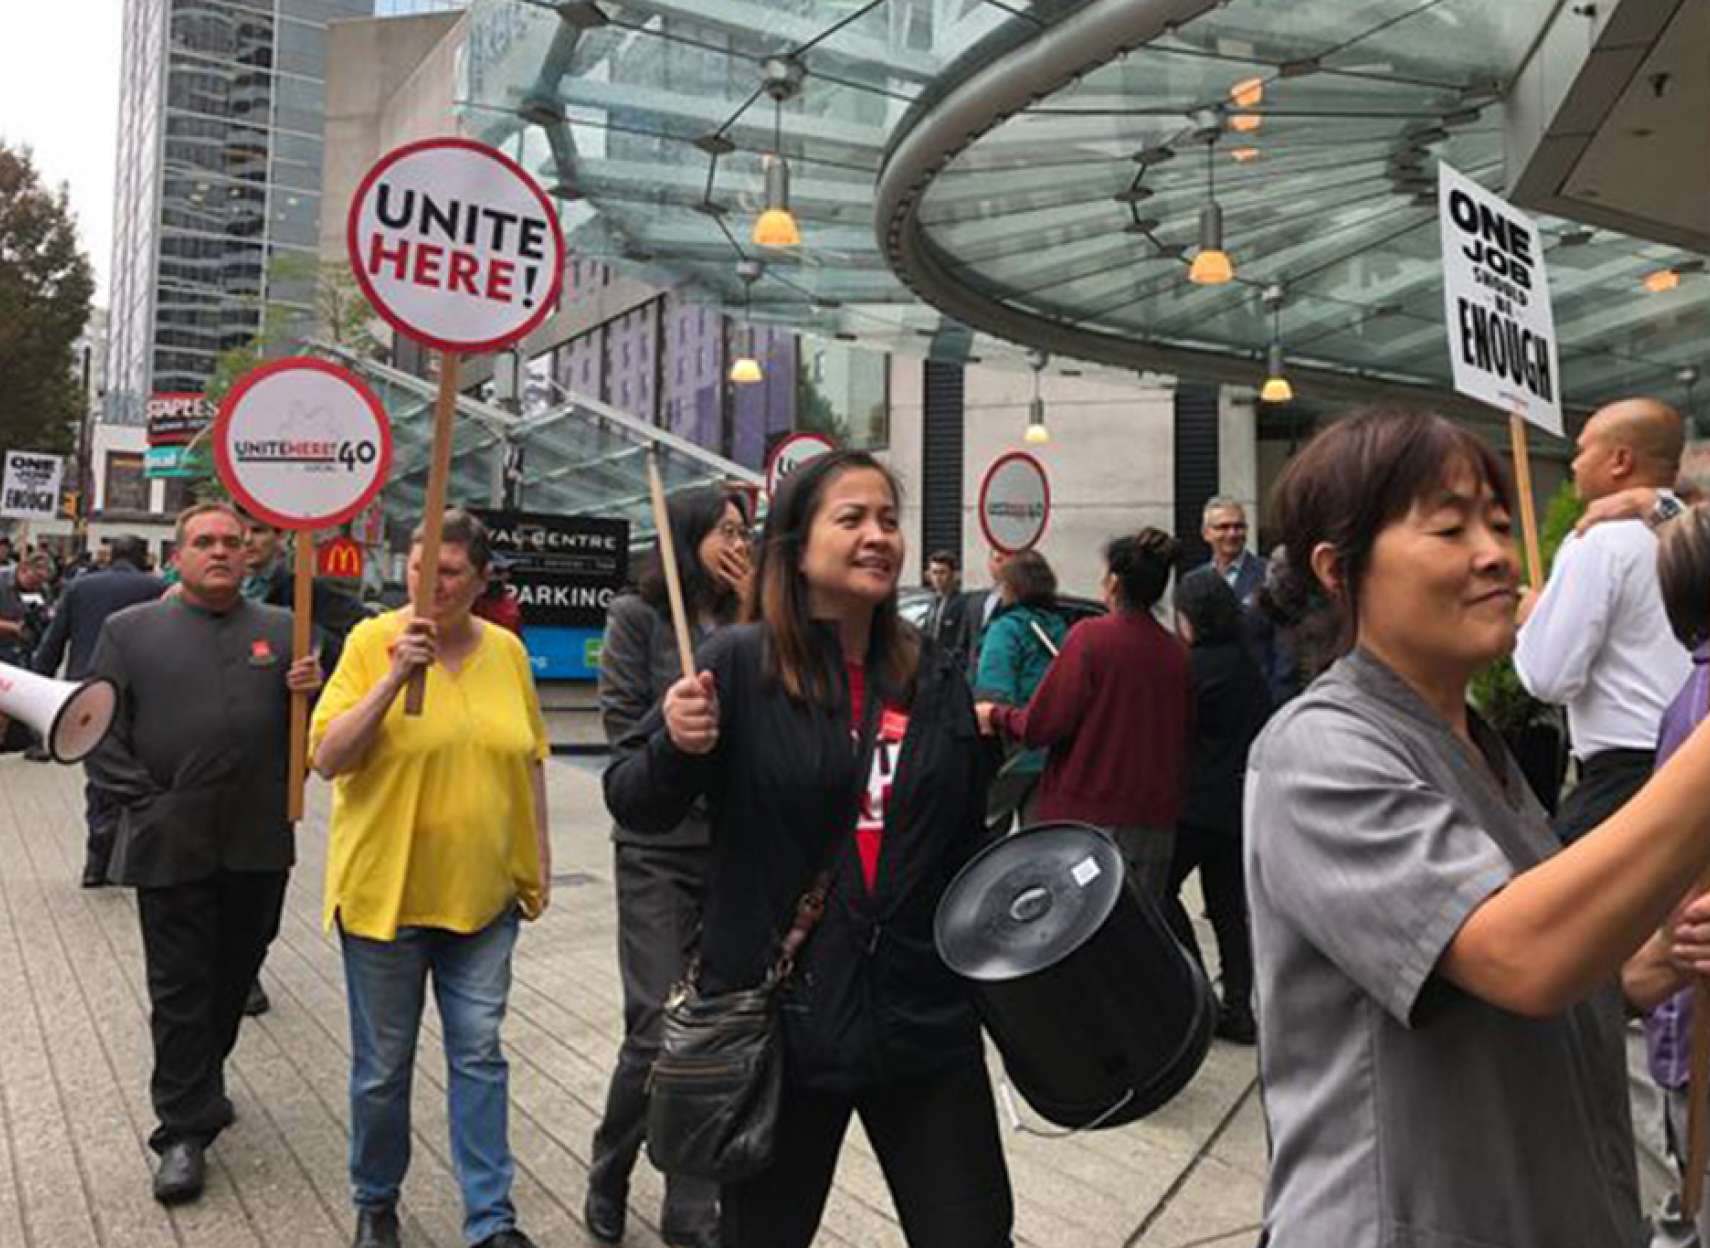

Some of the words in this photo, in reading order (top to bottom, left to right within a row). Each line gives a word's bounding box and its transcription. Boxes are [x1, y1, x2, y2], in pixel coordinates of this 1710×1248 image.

[376, 183, 547, 260] UNITE
[1450, 189, 1535, 268] ONE
[369, 232, 538, 309] HERE!
[1462, 239, 1531, 290] JOB
[1457, 297, 1553, 404] ENOUGH
[11, 456, 55, 474] ONE
[338, 440, 376, 472] 40
[531, 532, 617, 550] CENTRE
